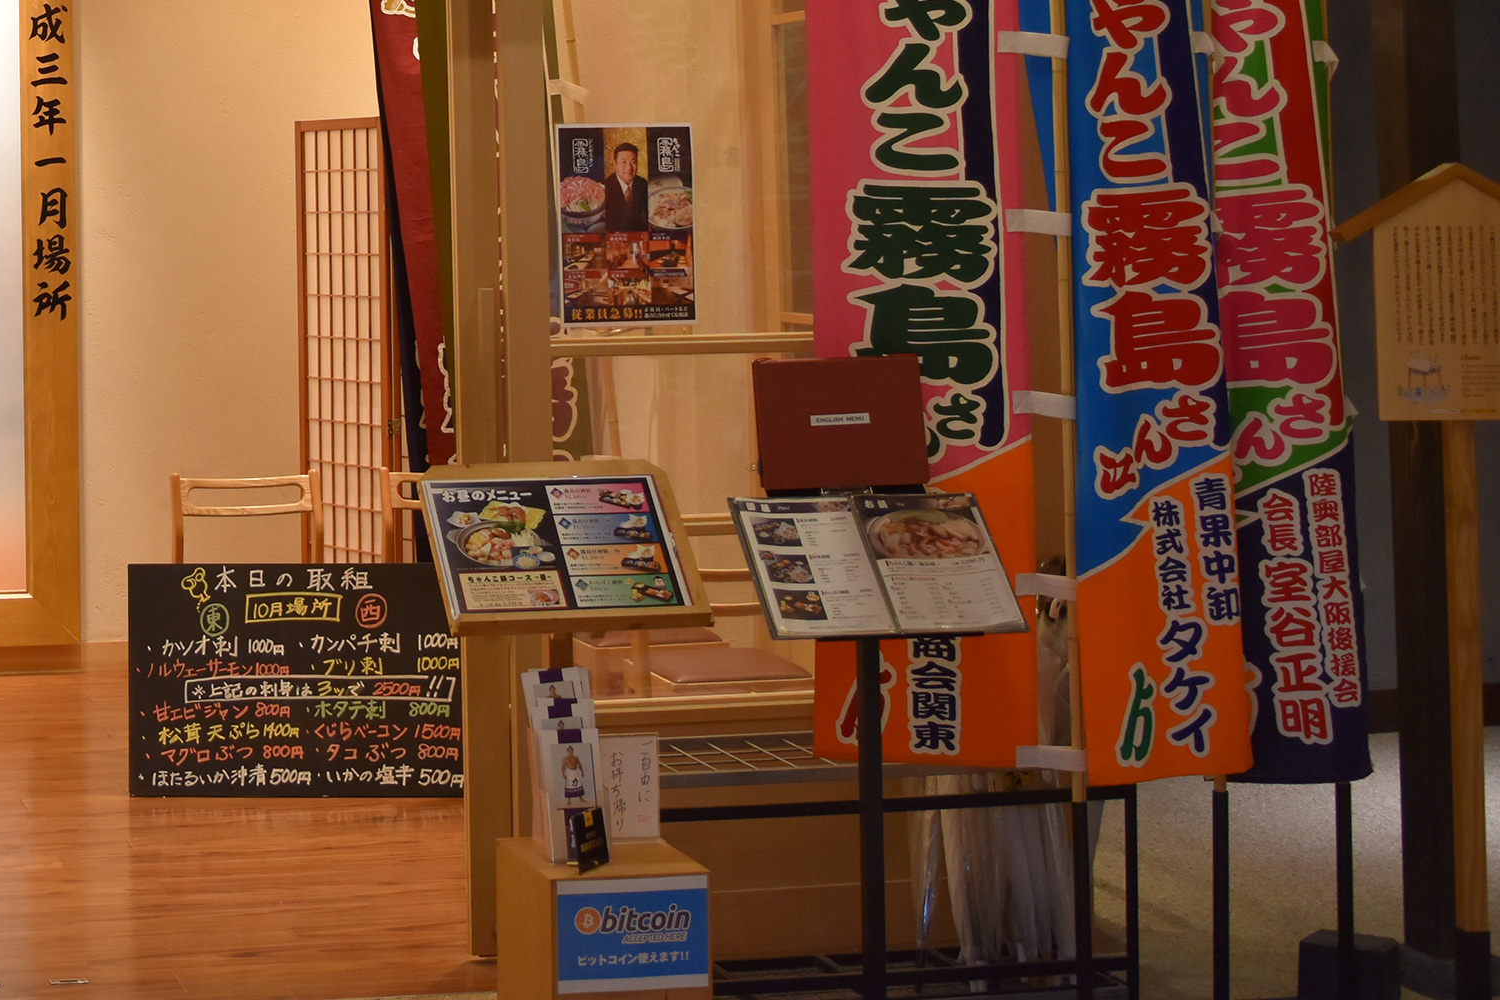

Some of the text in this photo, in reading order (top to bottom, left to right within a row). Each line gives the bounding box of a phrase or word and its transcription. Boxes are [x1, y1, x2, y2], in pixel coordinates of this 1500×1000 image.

[441, 487, 532, 503] お昼のメニュー
[1192, 475, 1241, 623] 青果中卸
[214, 565, 373, 593] 本日の取組
[1304, 469, 1359, 706] 陸奥部屋大阪後援会
[253, 597, 332, 619] 10月場所
[358, 596, 384, 625] 西
[203, 604, 226, 634] 東
[162, 634, 285, 657] カツオ刺 1000円
[311, 632, 459, 653] カンパチ刺 1000円
[255, 662, 290, 677] 1000円
[323, 656, 459, 676] ブリ刺 1000円
[152, 701, 291, 722] 甘エビジャン 800円
[314, 699, 450, 720] ホタテ刺 800円
[158, 722, 300, 745] 松茸天ぷら 1400円
[314, 721, 461, 741] くじらベーコン 1500円
[161, 744, 304, 766] マグロぶつ 800円
[326, 742, 459, 762] タコぶつ 800円
[269, 768, 312, 786] 500円
[418, 768, 464, 788] 500円
[638, 741, 652, 802] ご自由に
[610, 752, 626, 832] お持ち帰り
[600, 903, 691, 934] bitcoin
[622, 931, 688, 944] ACCEPTED HERE
[577, 950, 690, 967] ビットコイン使えます!!
